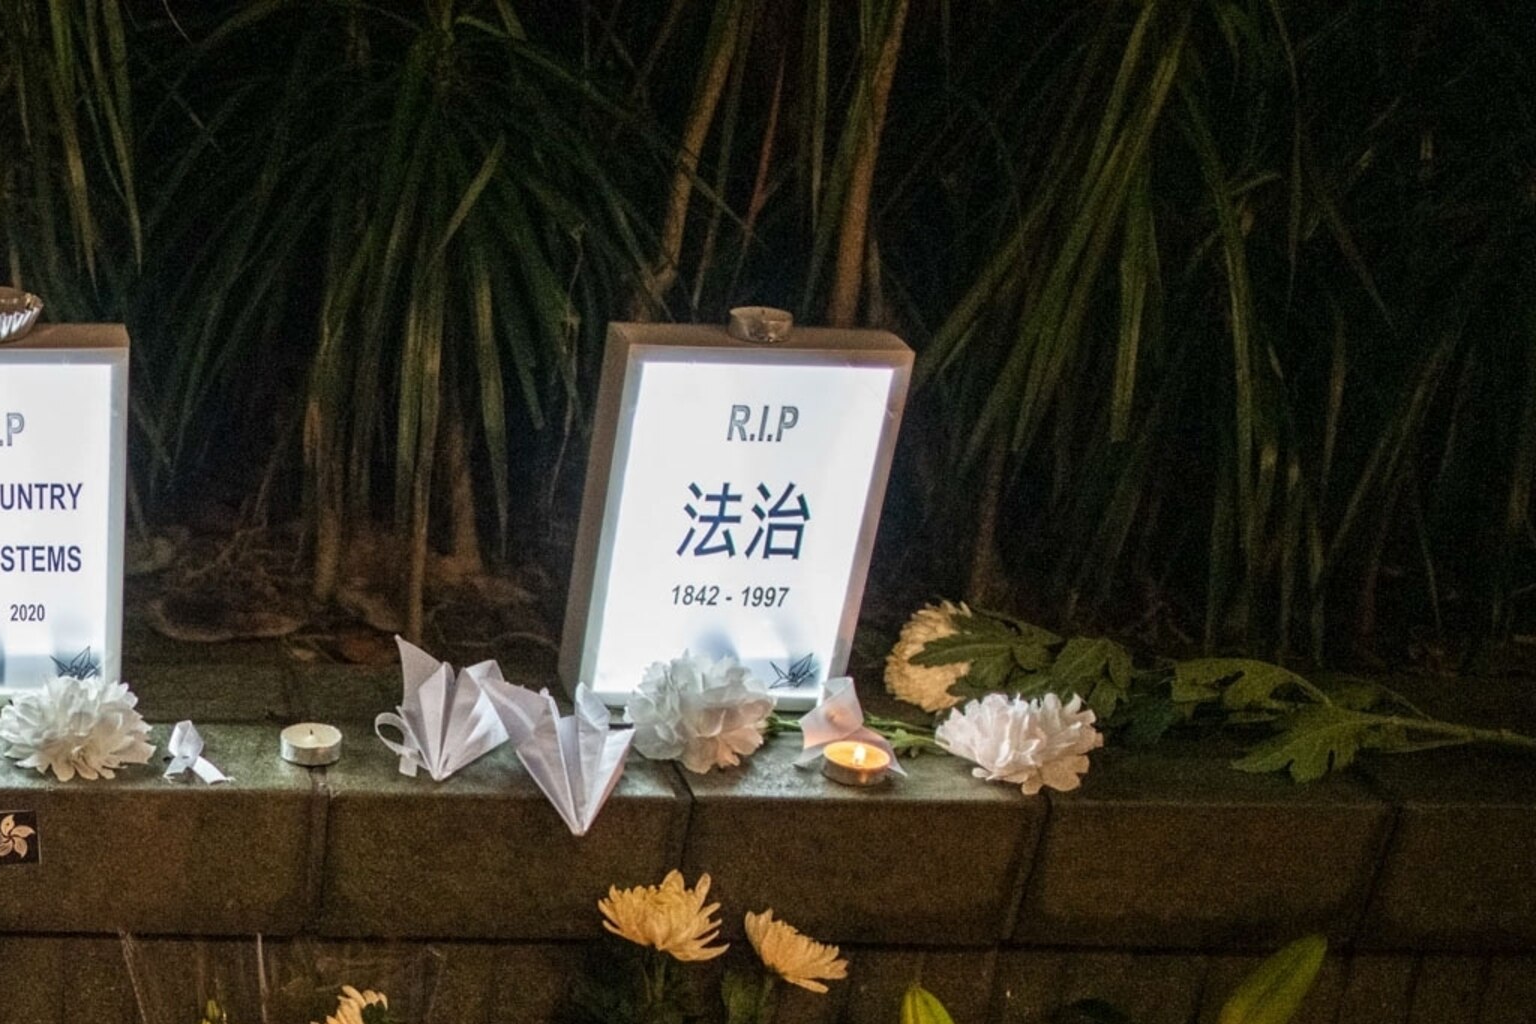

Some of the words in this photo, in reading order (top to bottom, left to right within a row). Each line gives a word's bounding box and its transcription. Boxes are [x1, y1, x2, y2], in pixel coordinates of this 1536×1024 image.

[726, 403, 800, 443] R.I.P
[675, 481, 811, 561] 法治
[671, 584, 721, 607] 1842
[741, 585, 791, 609] 1997
[9, 603, 46, 623] 2020
